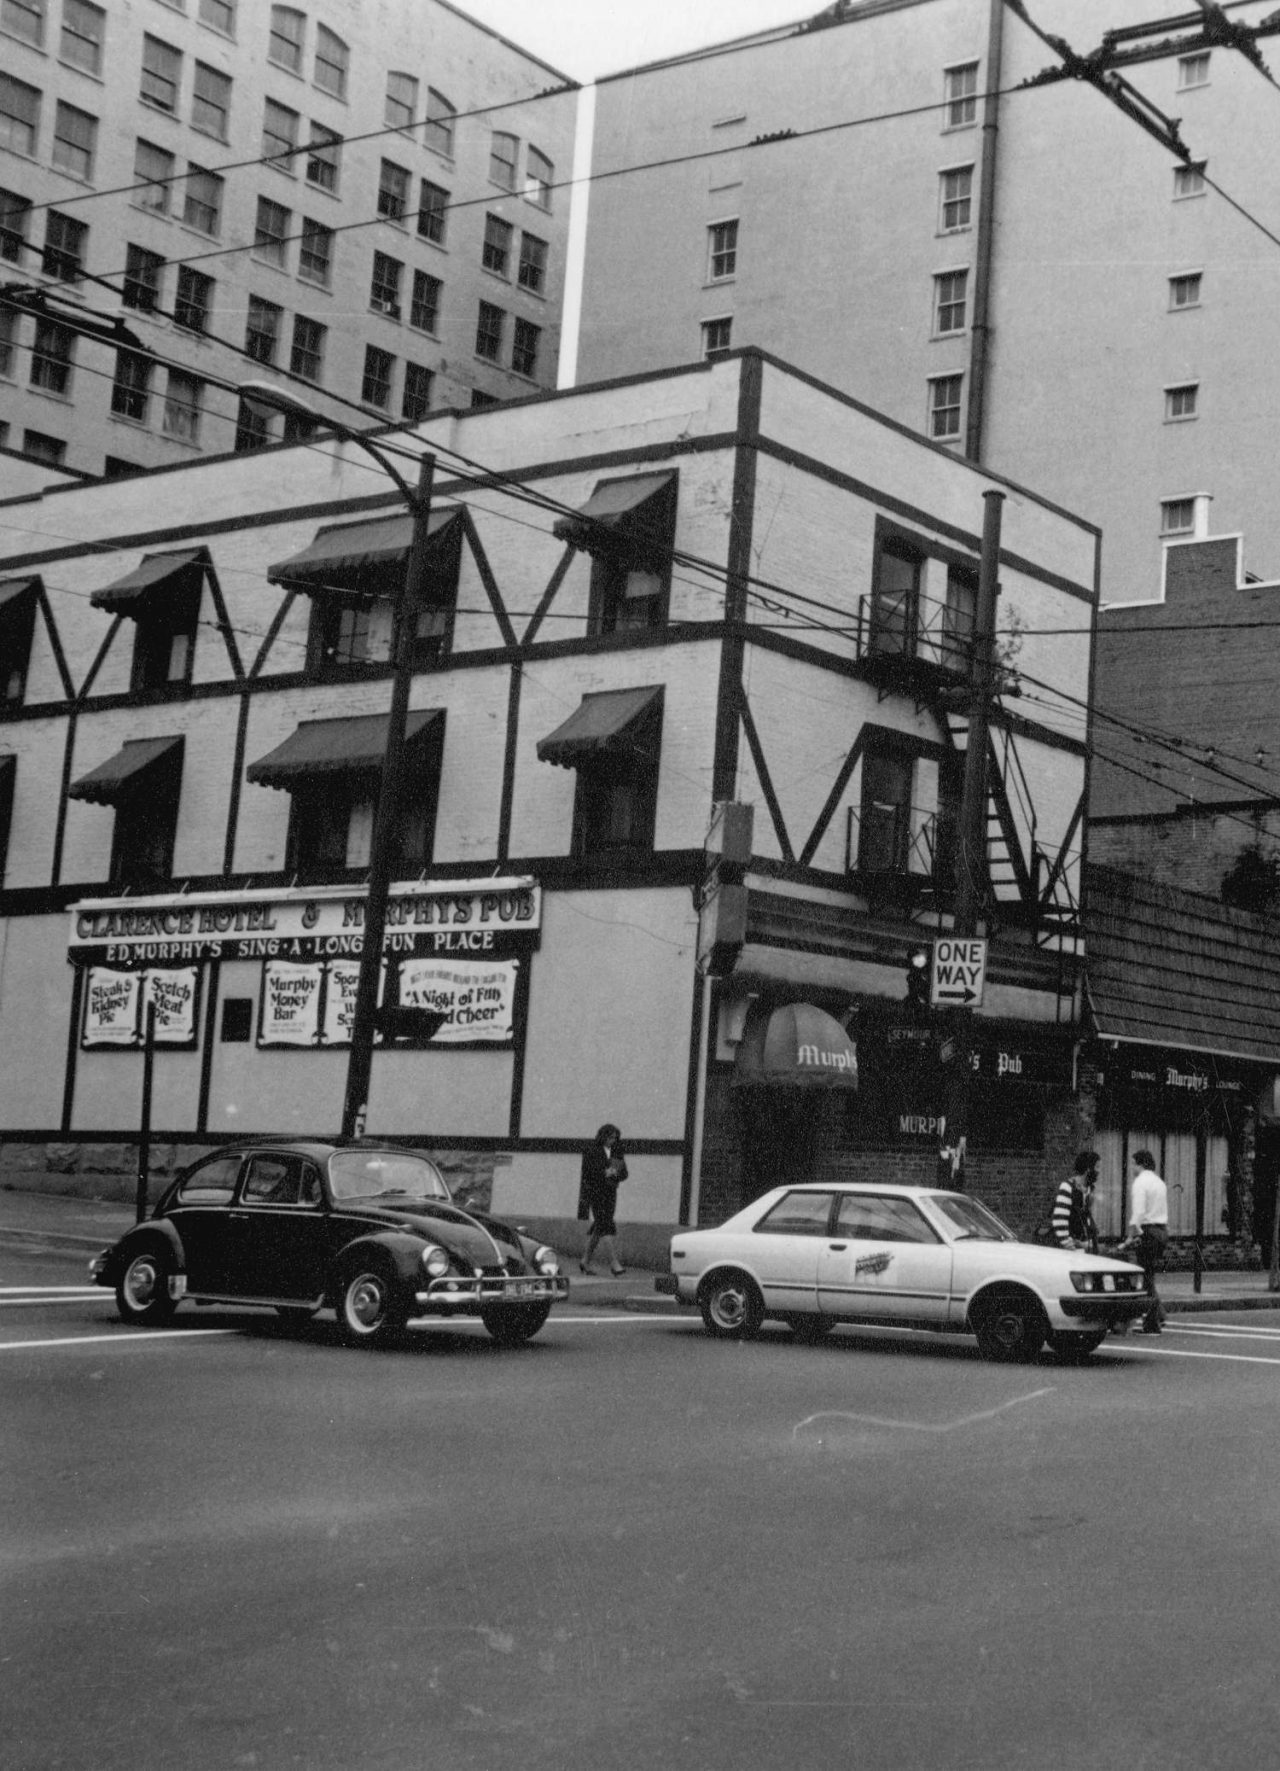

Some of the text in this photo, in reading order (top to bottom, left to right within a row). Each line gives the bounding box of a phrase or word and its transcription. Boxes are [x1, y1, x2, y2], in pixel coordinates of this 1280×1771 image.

[76, 906, 195, 939] CLARENCE
[197, 902, 277, 933] HOTEL
[342, 895, 473, 927] MRPHYS
[480, 891, 536, 923] PUB
[106, 944, 130, 962] ED
[133, 940, 223, 960] MURPHY'S
[382, 932, 416, 952] FUN
[433, 931, 494, 951] PLACE
[937, 942, 983, 964] ONE
[268, 976, 318, 994] Murphy
[936, 964, 981, 986] WAY
[151, 976, 191, 1002] Scotch
[422, 989, 456, 1010] Night
[458, 988, 475, 1006] of
[91, 995, 130, 1015] Kidney
[154, 993, 184, 1015] Meat
[270, 992, 309, 1010] Money
[98, 1010, 116, 1026] Pie
[273, 1006, 297, 1020] Bar
[797, 1044, 858, 1074] Murph
[997, 1051, 1022, 1077] Pub
[1131, 1066, 1241, 1092] DINING Murphy's LOUNGE
